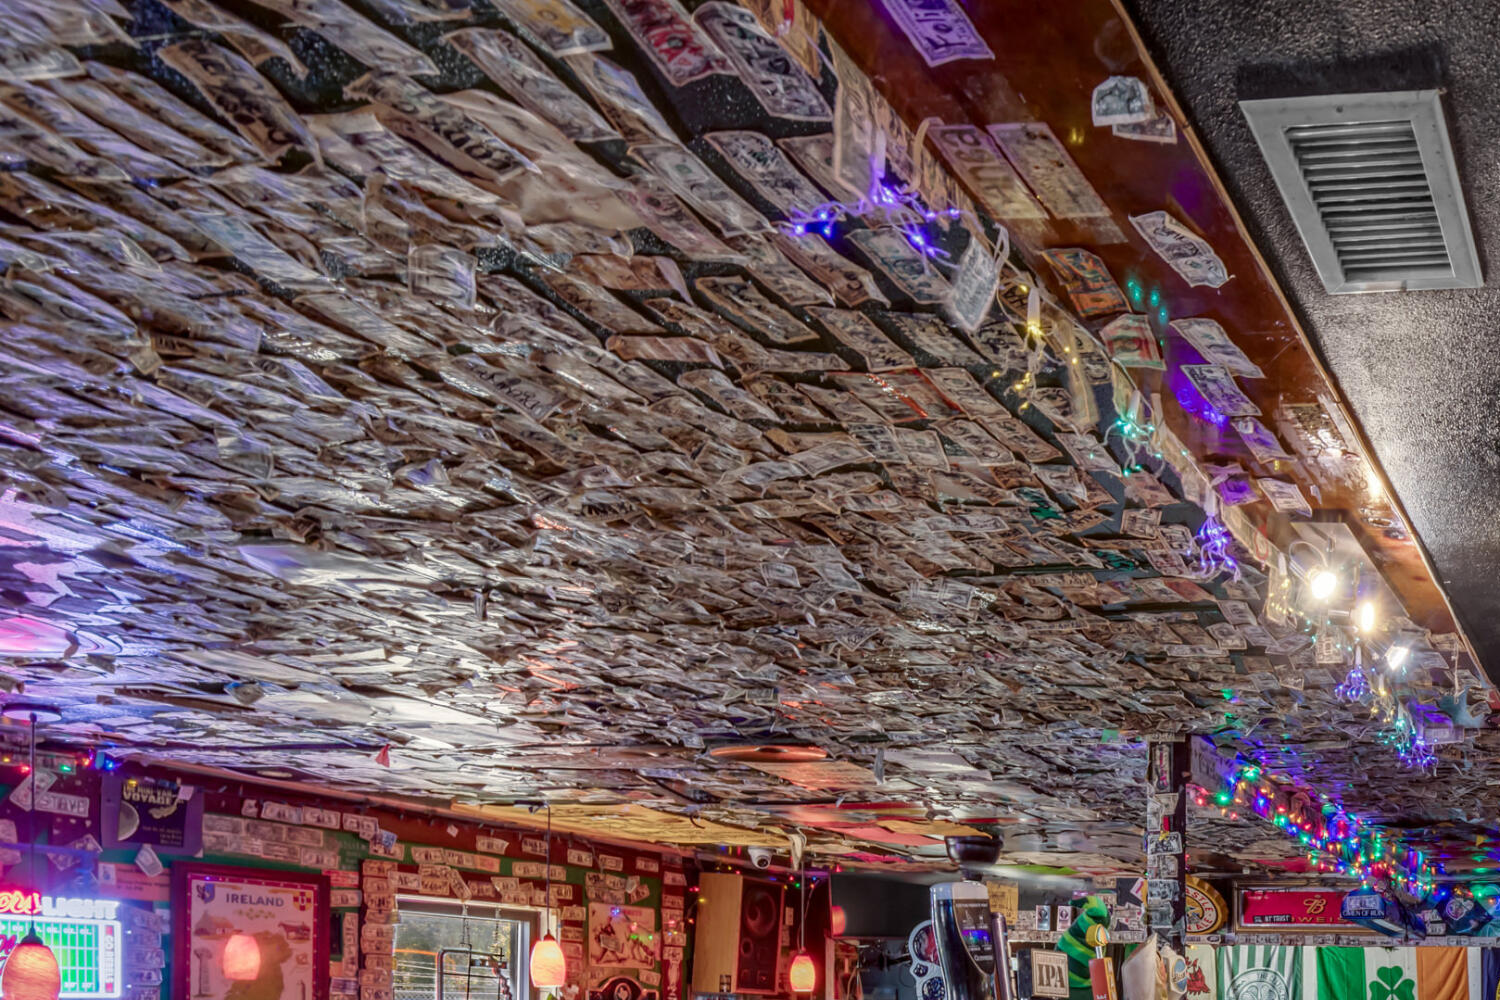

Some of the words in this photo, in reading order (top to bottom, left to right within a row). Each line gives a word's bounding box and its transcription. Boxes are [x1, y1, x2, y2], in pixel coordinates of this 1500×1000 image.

[41, 896, 119, 920] LIGHT
[226, 893, 284, 908] IRELAND
[1038, 964, 1066, 988] IPA
